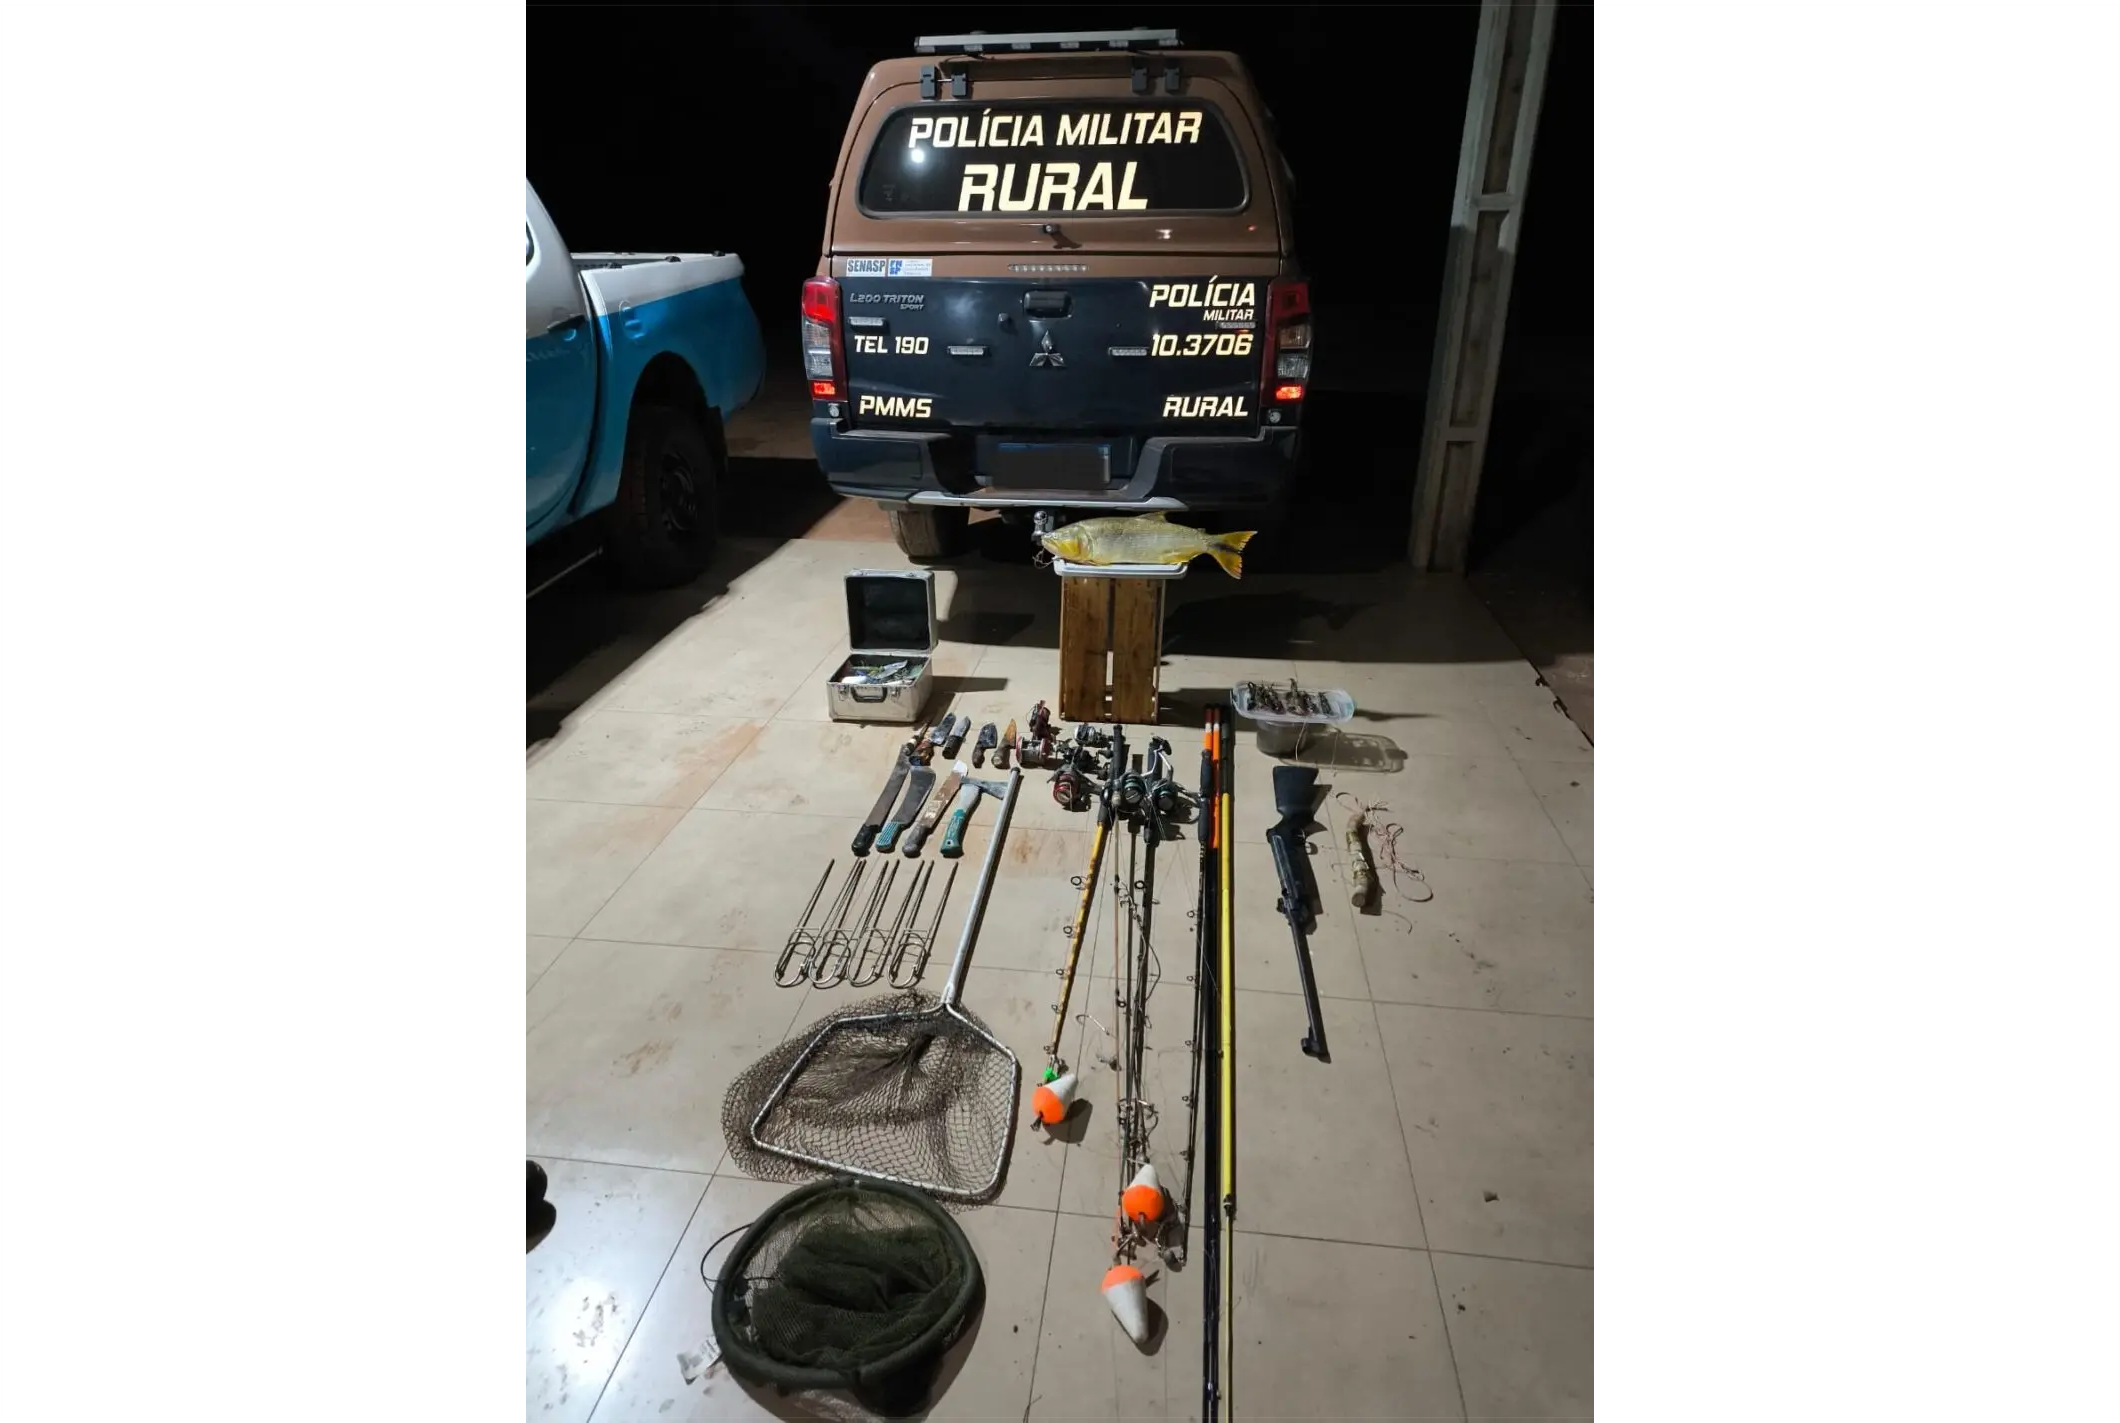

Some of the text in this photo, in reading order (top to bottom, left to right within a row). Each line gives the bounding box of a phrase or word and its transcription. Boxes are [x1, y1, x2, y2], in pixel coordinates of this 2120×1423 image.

[908, 108, 1203, 149] POLÍCIA MILITAR
[958, 162, 1148, 211] RURAL
[847, 260, 886, 273] SENASP
[849, 292, 925, 304] L200 TRITON
[1149, 275, 1255, 308] POLÍCIA
[1203, 309, 1254, 321] MILITAR
[854, 335, 930, 355] TEL 190
[1151, 333, 1254, 357] 10.3706
[859, 395, 933, 419] PMMS
[1162, 396, 1249, 418] RURAL
